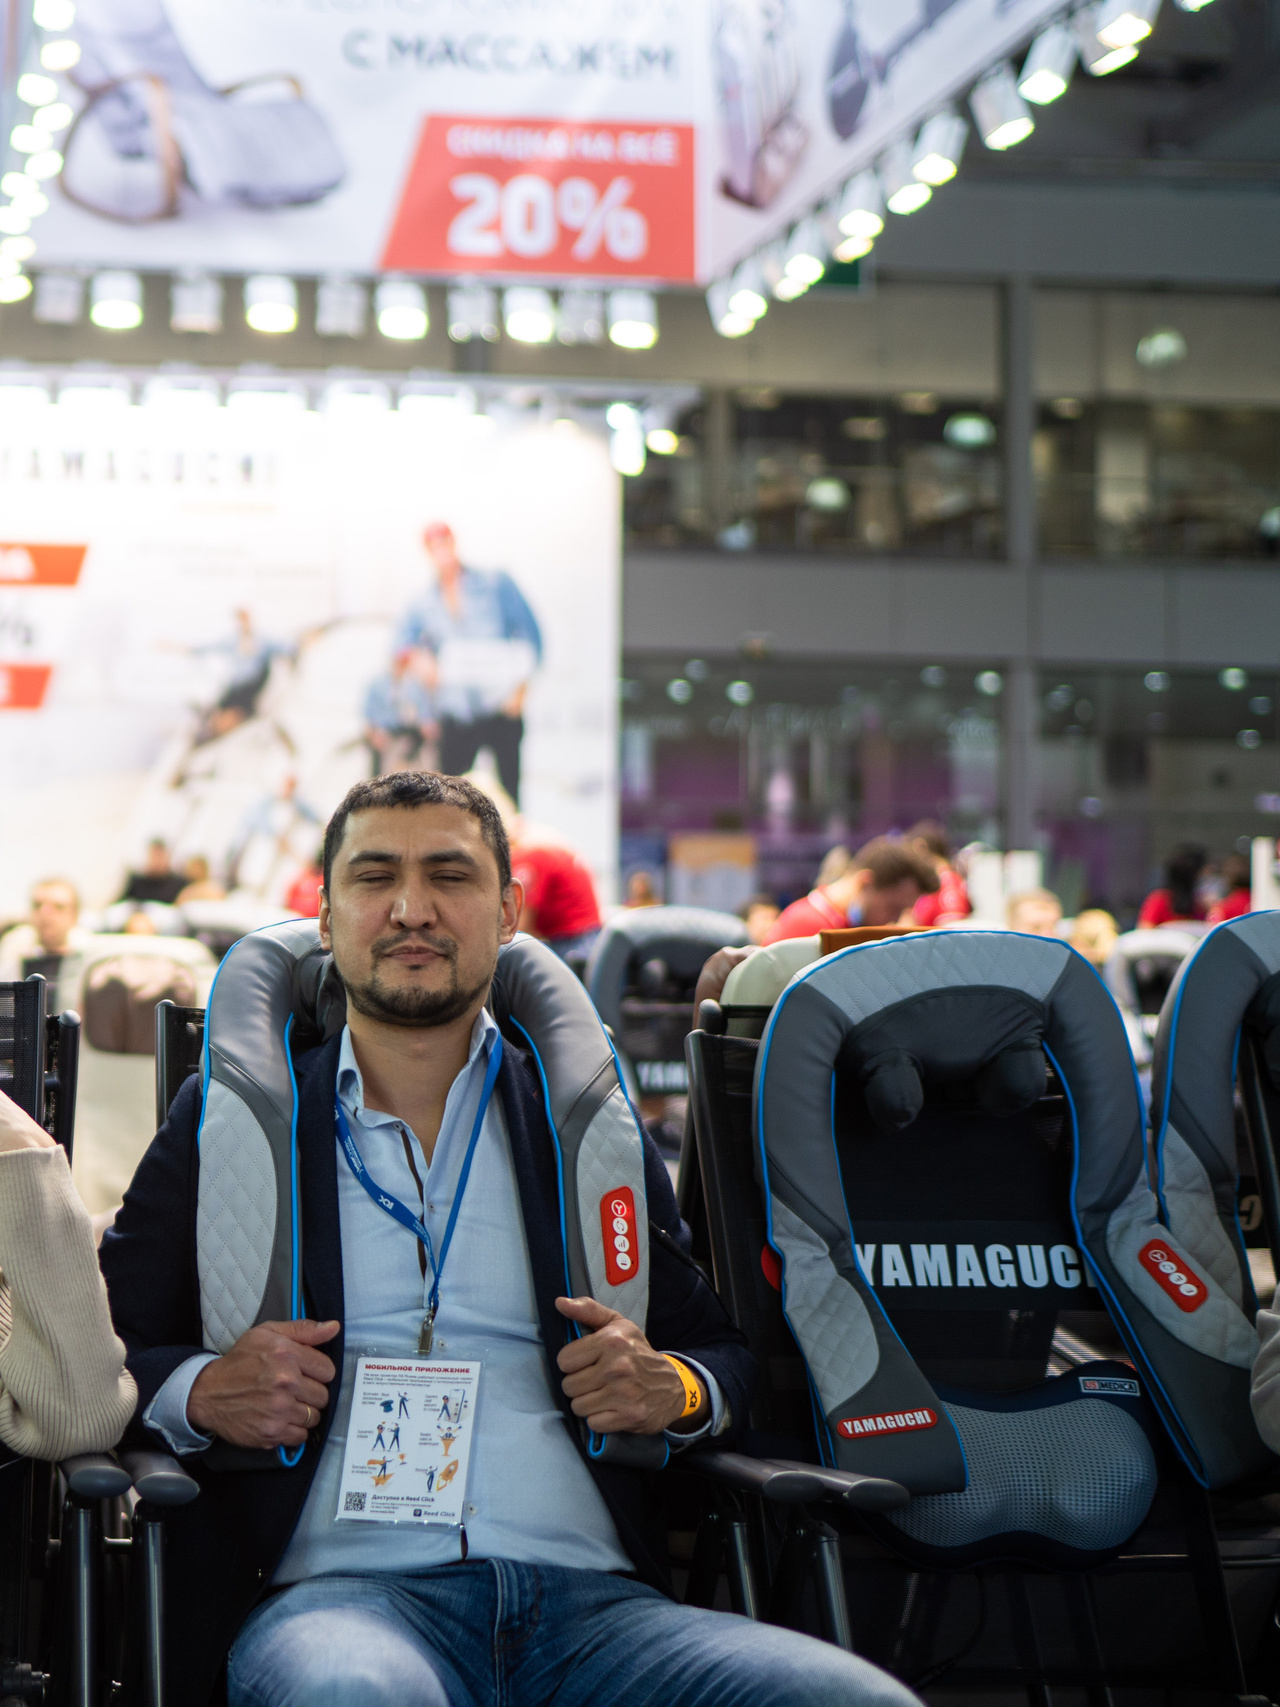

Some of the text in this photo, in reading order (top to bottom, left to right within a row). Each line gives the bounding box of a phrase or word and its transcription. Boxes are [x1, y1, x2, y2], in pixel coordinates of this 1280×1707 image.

[447, 172, 648, 262] 20%
[364, 1363, 470, 1374] МОБИЛЬНОЕ ПРИЛОЖЕНИЕ
[1084, 1380, 1134, 1391] US MEDICA
[843, 1410, 931, 1434] YAMAGUCHI
[371, 1494, 399, 1503] Доступно
